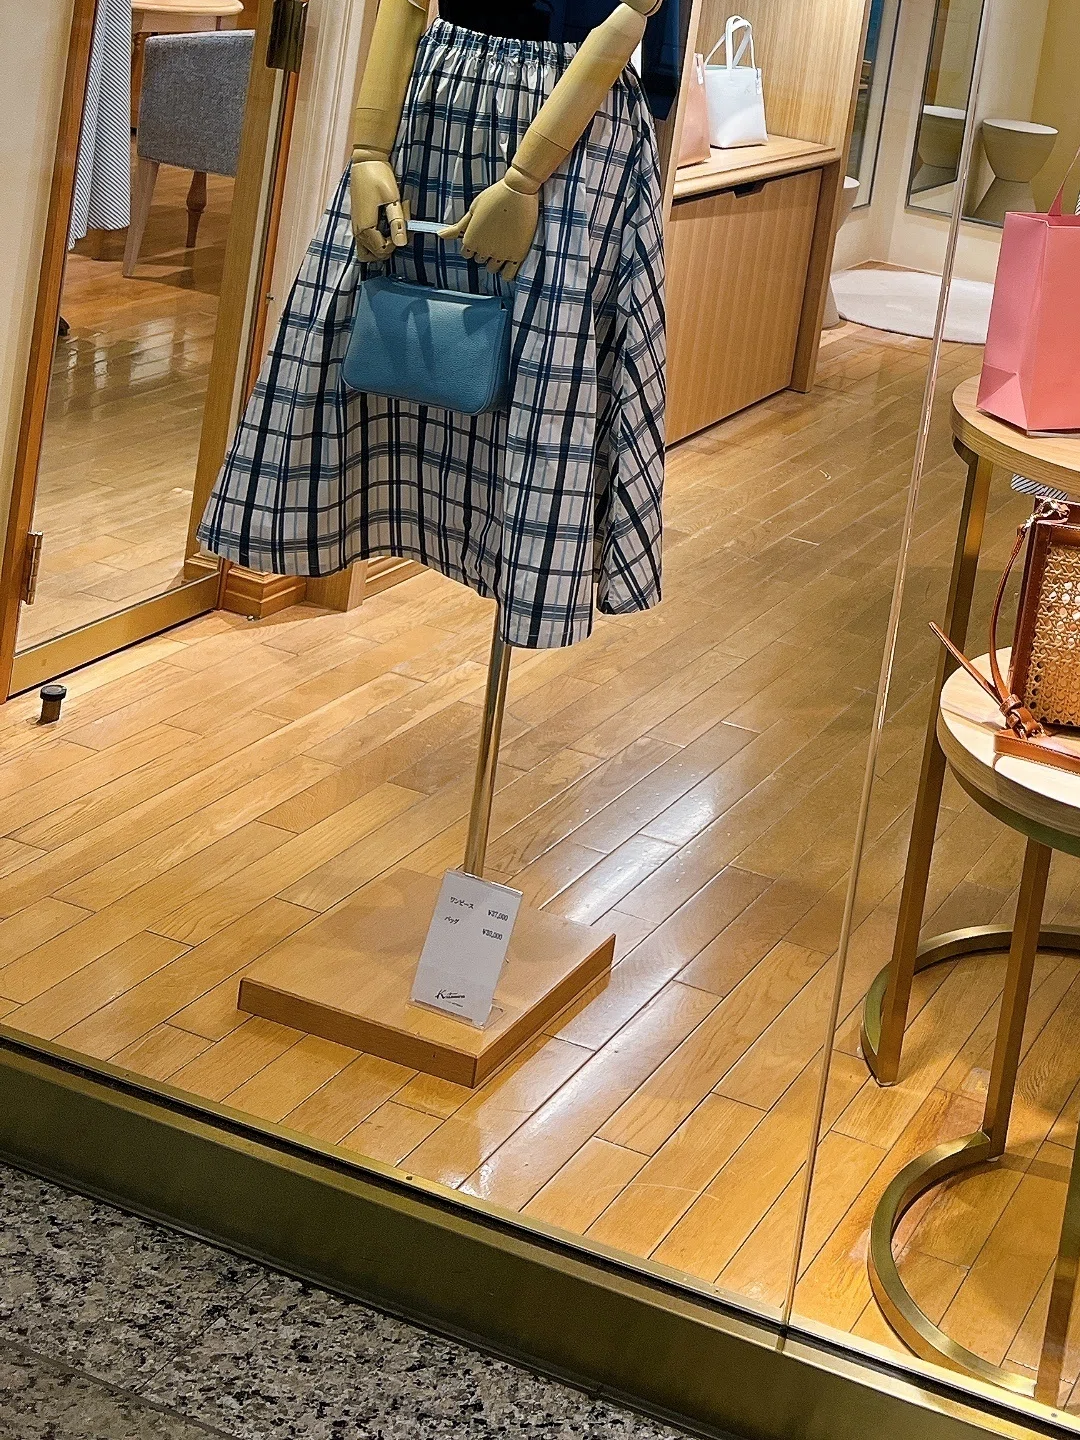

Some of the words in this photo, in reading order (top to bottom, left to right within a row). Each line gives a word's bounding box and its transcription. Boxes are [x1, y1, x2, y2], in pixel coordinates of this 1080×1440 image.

[450, 896, 475, 909] ワンピース
[444, 915, 460, 925] バッグ
